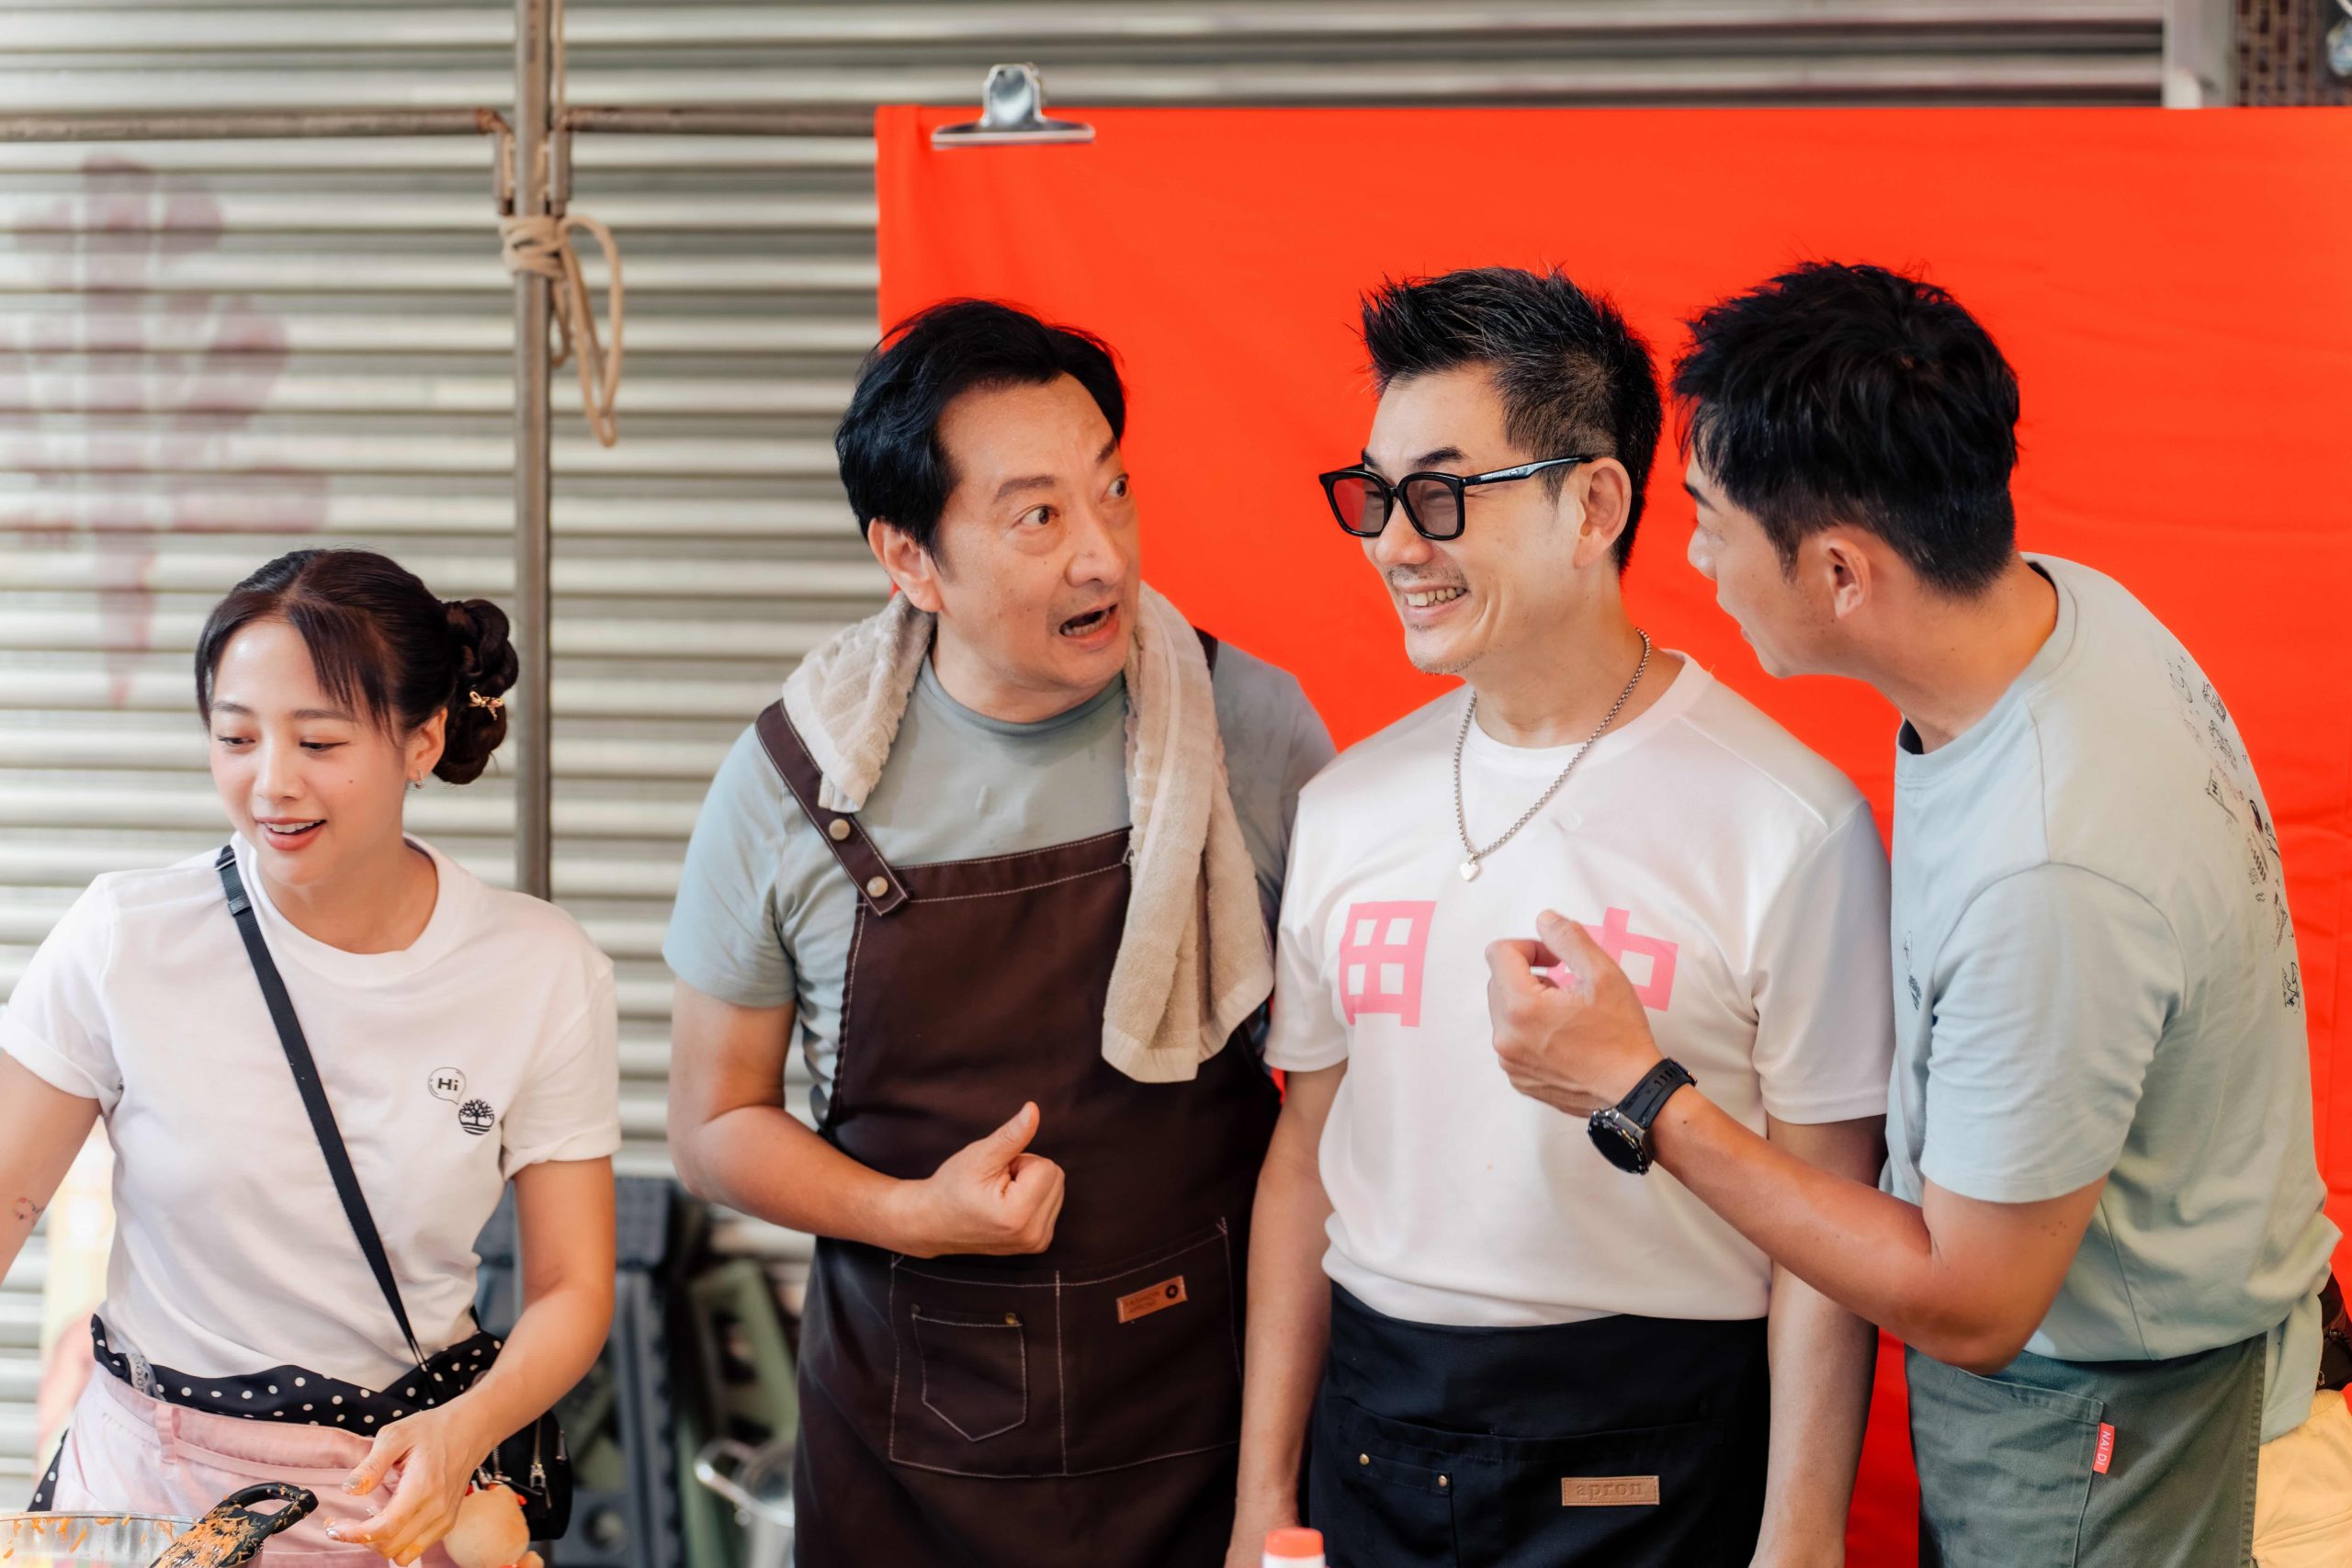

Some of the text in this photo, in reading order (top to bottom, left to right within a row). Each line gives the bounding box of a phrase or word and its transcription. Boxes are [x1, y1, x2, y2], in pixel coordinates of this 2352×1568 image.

[437, 1077, 459, 1091] Hi
[2097, 1430, 2112, 1466] NAI DI
[1576, 1483, 1642, 1501] apron
